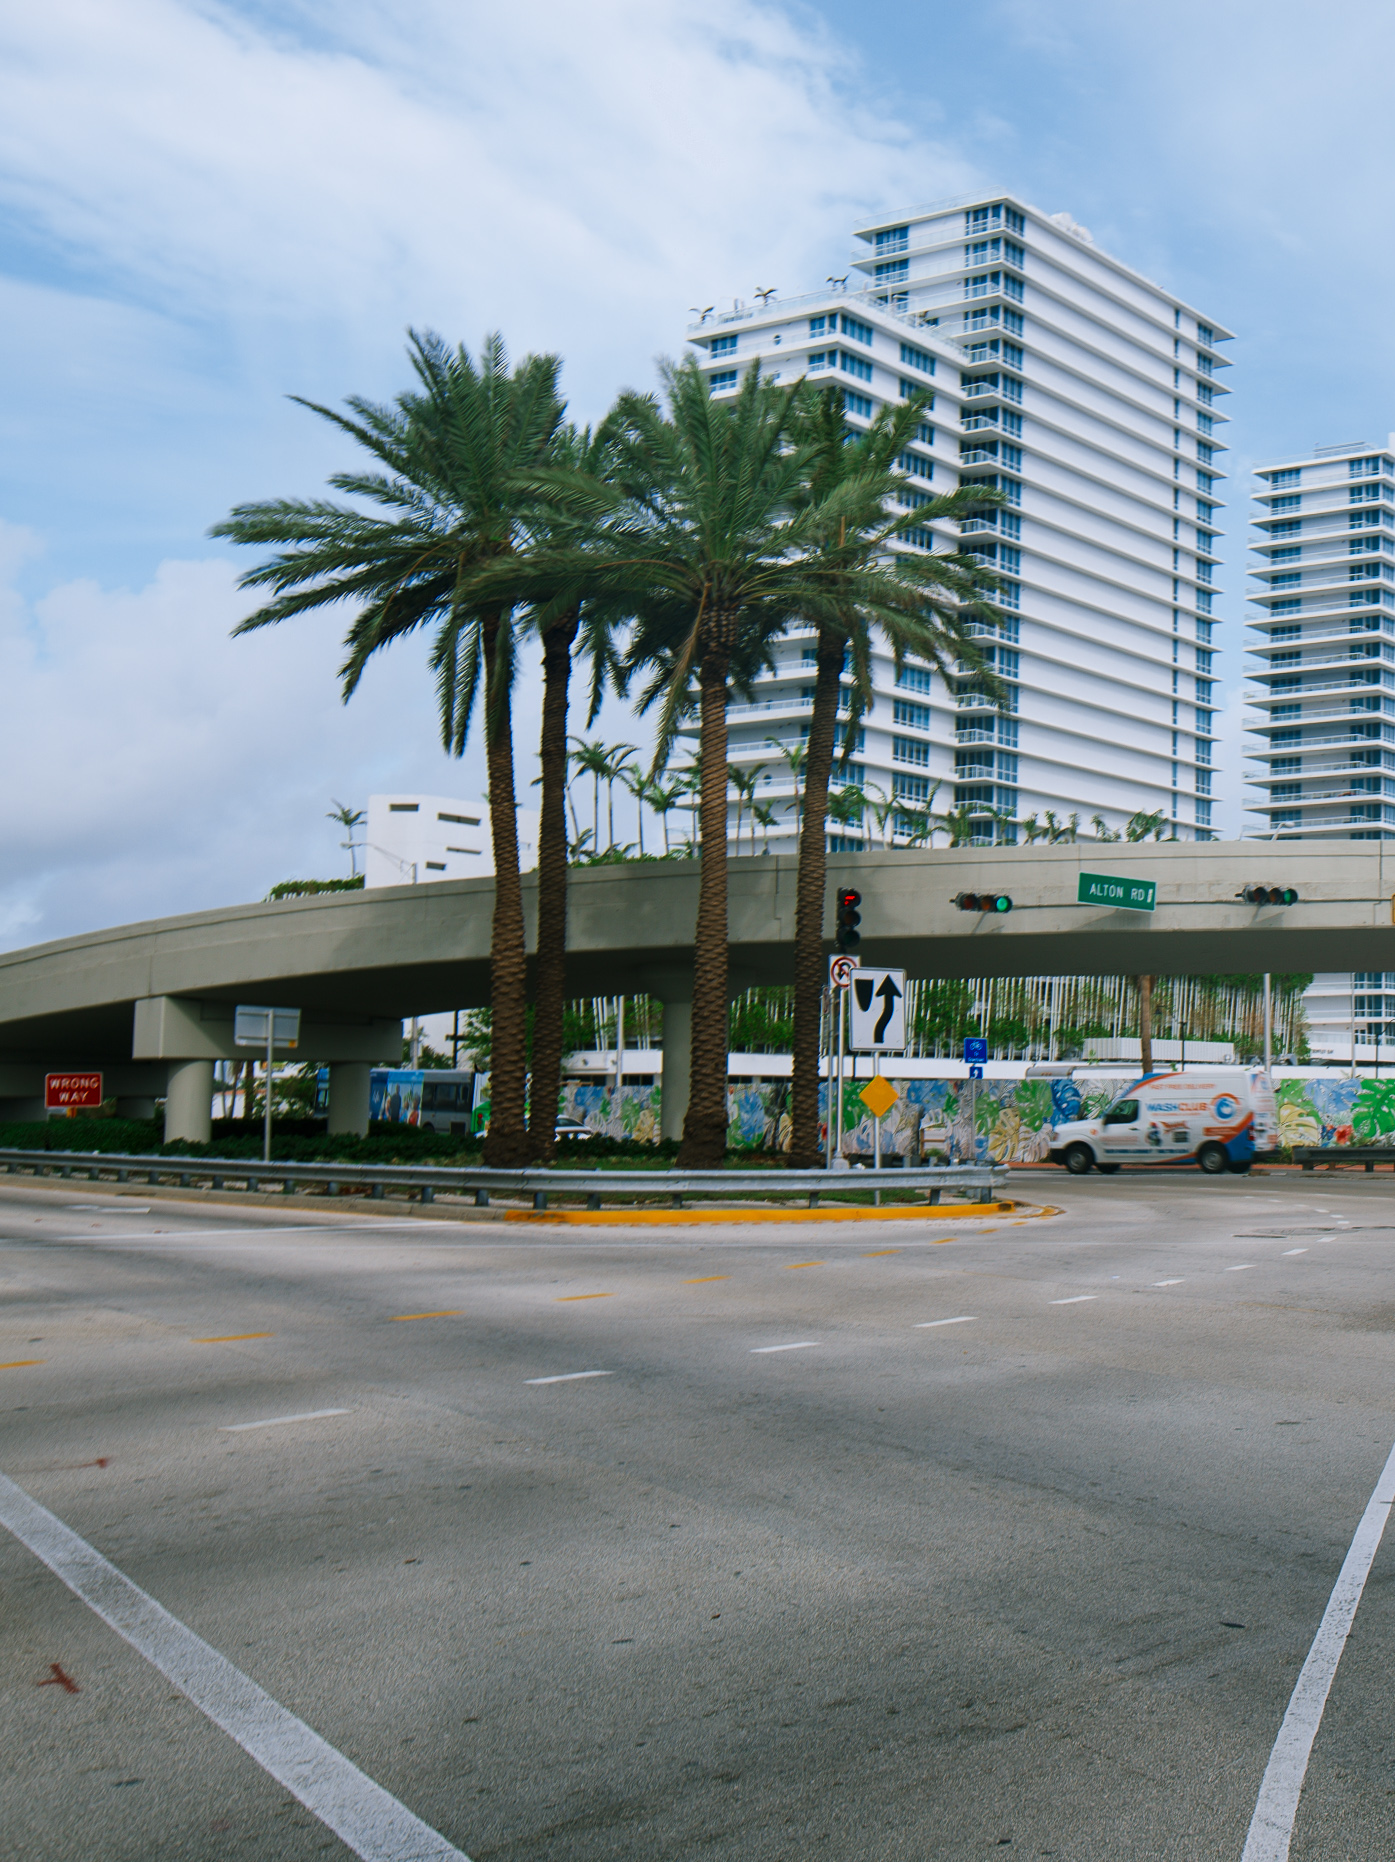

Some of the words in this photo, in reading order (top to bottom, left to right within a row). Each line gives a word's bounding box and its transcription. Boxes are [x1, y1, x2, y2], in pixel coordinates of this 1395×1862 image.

[1089, 882, 1124, 898] ALTON
[1130, 887, 1145, 901] RD
[50, 1077, 100, 1090] WRONG
[58, 1090, 90, 1103] WAY
